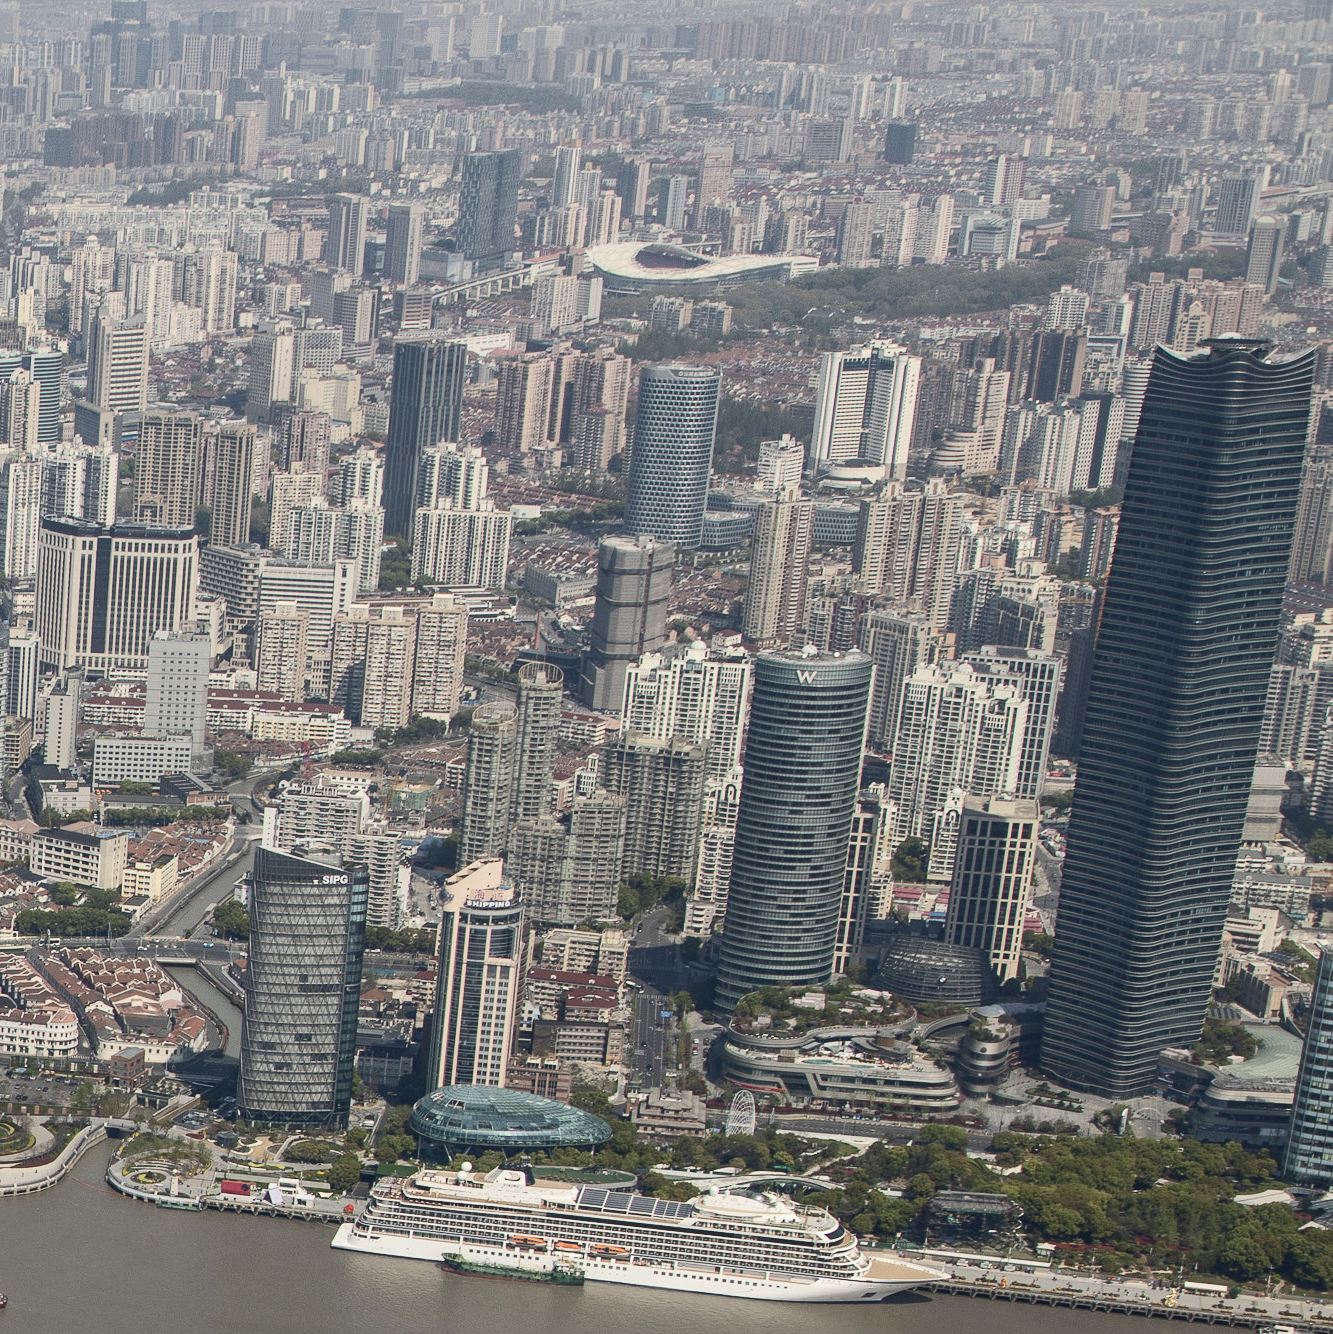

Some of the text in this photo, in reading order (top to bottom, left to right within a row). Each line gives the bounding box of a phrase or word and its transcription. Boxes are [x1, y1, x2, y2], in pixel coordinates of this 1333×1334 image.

[796, 669, 818, 685] W
[322, 875, 349, 885] SIPG
[466, 900, 511, 908] SHIPPING
